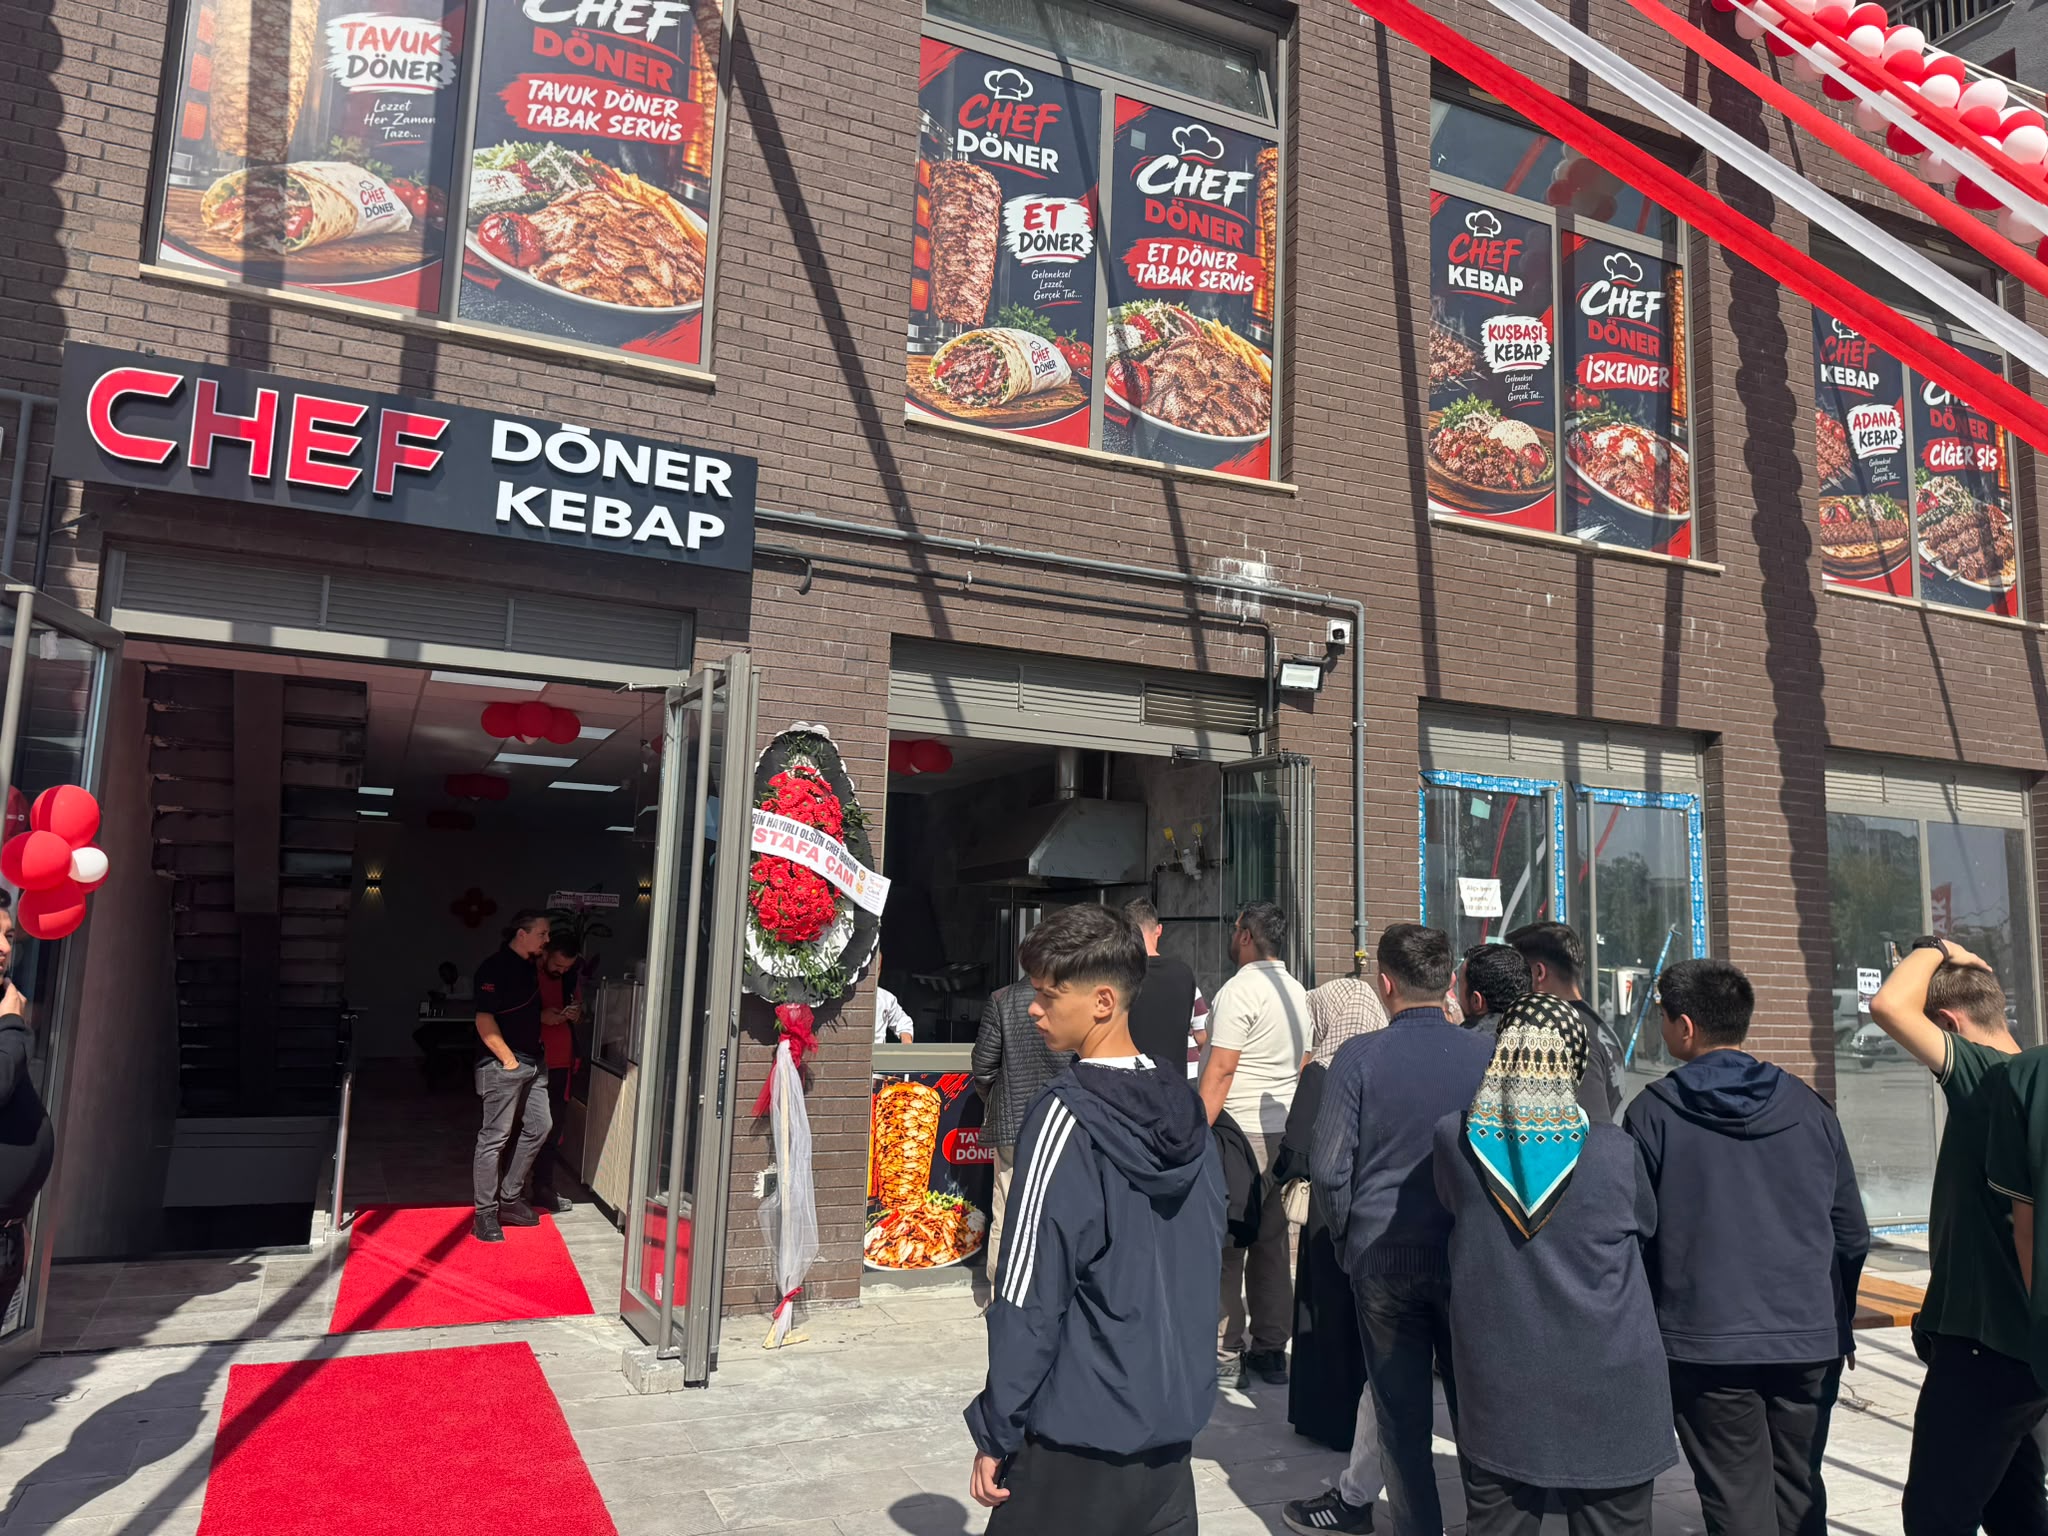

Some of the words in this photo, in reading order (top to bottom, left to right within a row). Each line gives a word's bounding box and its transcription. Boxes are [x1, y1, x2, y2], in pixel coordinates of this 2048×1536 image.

[339, 22, 442, 56] TAVUK
[345, 53, 444, 82] DÖNER
[532, 26, 673, 93] DÖNER
[373, 99, 412, 112] Lezzet
[528, 79, 598, 107] TAVUK
[604, 88, 680, 119] DÖNER
[363, 114, 388, 126] Her
[392, 113, 436, 125] Zaman
[527, 103, 602, 132] TABAK
[607, 115, 683, 142] SERVİS
[958, 93, 1063, 144] CHEF
[957, 128, 1059, 174] DÖNER
[1136, 154, 1255, 208] CHEF
[360, 187, 386, 206] CHEF
[1023, 202, 1067, 232] ET
[1145, 198, 1244, 249] DÖNER
[1018, 230, 1085, 253] DÖNER
[1147, 242, 1173, 264] ET
[1177, 244, 1238, 271] DÖNER
[1448, 232, 1524, 275] CHEF
[1031, 269, 1072, 280] Geleneksel
[1039, 280, 1065, 290] Lezzet,
[1136, 263, 1195, 287] TABAK
[1198, 270, 1255, 292] SERVİS
[1448, 264, 1524, 297] KEBAP
[1033, 290, 1061, 301] Gerçek
[1062, 288, 1083, 299] Tat...
[1580, 280, 1666, 323] CHEF
[1488, 323, 1543, 343] KUŞBAŞI
[1588, 319, 1660, 358] DÖNER
[1031, 347, 1051, 365] CHEF
[1034, 359, 1057, 376] DÖNER
[1494, 343, 1543, 363] KEBAP
[1820, 335, 1877, 371] CHEF
[1586, 354, 1669, 388] İSKENDER
[1820, 363, 1880, 390] KEBAP
[86, 366, 451, 497] CHEF
[1853, 411, 1897, 431] ADANA
[1930, 405, 1989, 442] DÖNER
[1859, 430, 1898, 449] KEBAP
[1930, 440, 1975, 466] CİĞER
[1976, 444, 1998, 471] ŞİŞ
[496, 480, 726, 550] KEBAP
[766, 817, 799, 836] HAYIRLI
[799, 827, 826, 847] OLSUN
[753, 828, 819, 863] STAFA
[825, 855, 855, 888] ÇAM
[956, 1145, 995, 1160] DÖNE
